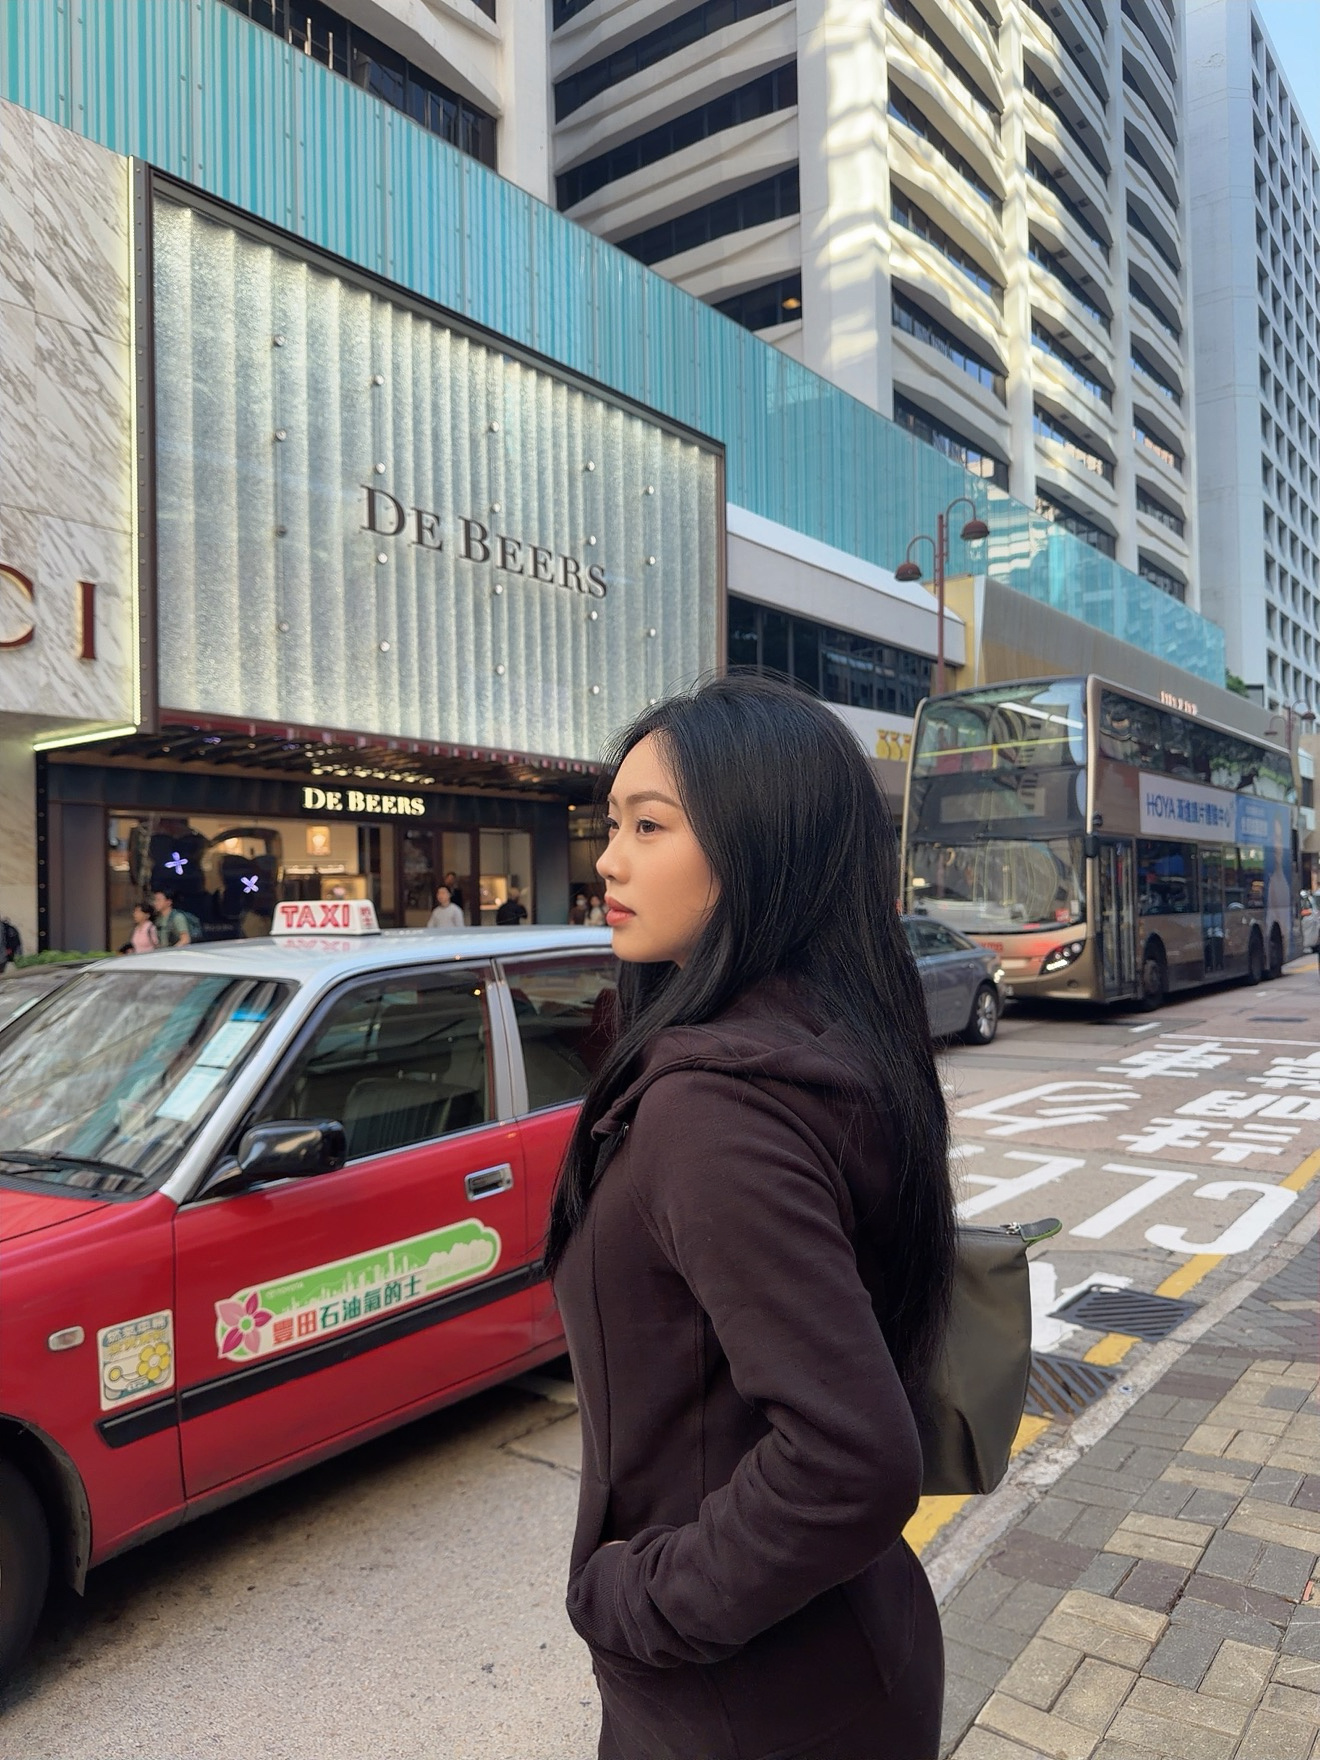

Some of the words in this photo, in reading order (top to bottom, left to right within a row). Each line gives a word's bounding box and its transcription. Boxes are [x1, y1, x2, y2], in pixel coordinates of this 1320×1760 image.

[360, 484, 443, 552] DE
[458, 515, 608, 600] BEERS
[302, 786, 343, 811] DE
[347, 790, 426, 816] BEERS
[1146, 793, 1176, 819] HOYA
[280, 903, 351, 928] TAXI
